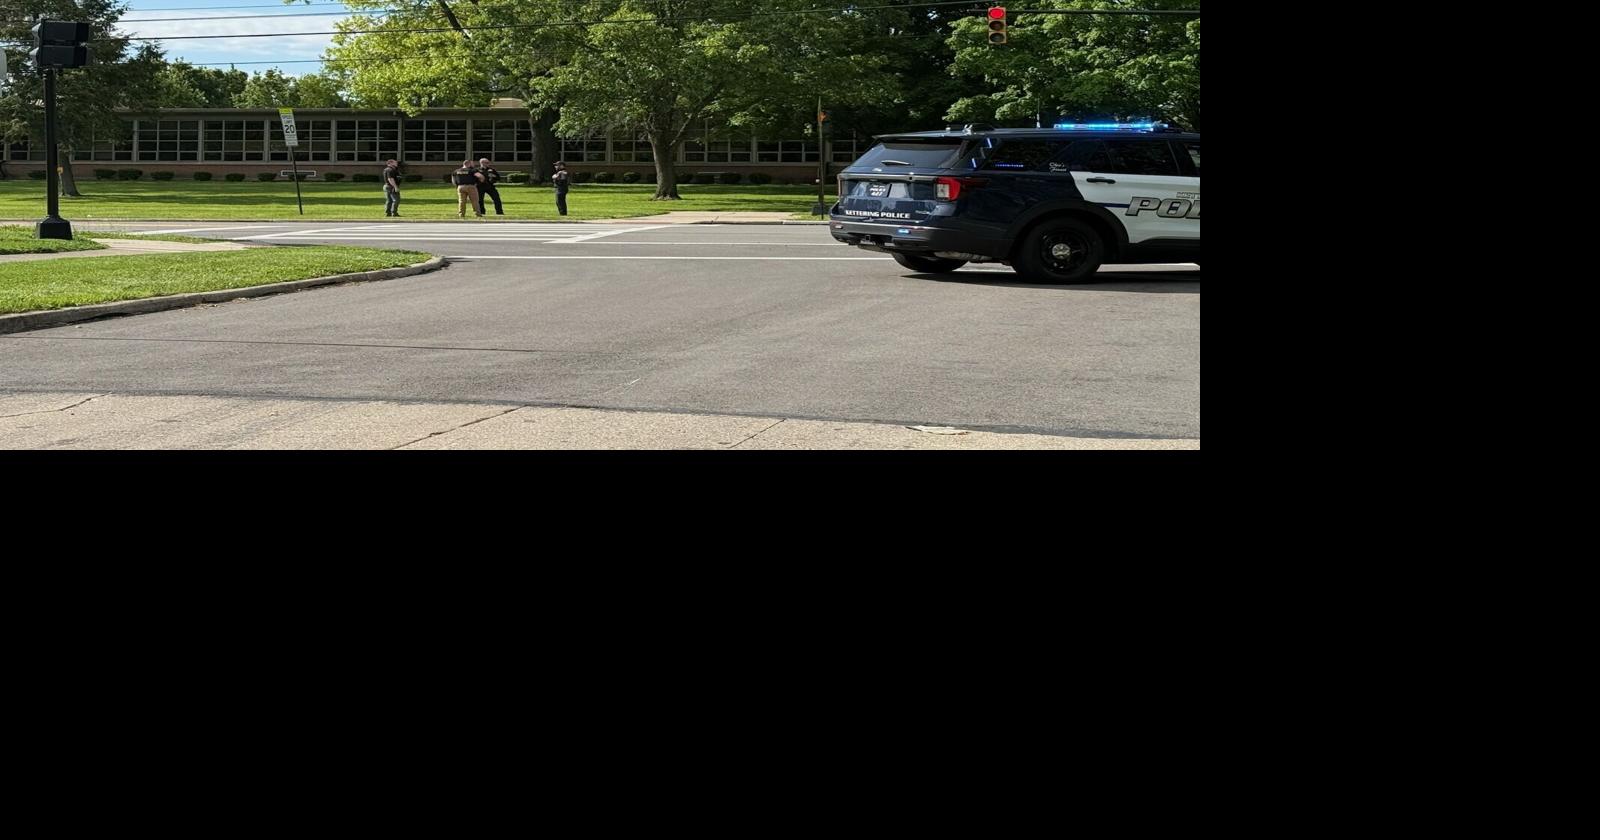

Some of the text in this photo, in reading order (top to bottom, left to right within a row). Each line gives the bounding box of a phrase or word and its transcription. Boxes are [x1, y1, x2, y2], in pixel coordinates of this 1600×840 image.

[284, 124, 295, 134] 20
[845, 210, 880, 218] KETTERING
[880, 211, 911, 219] POLICE
